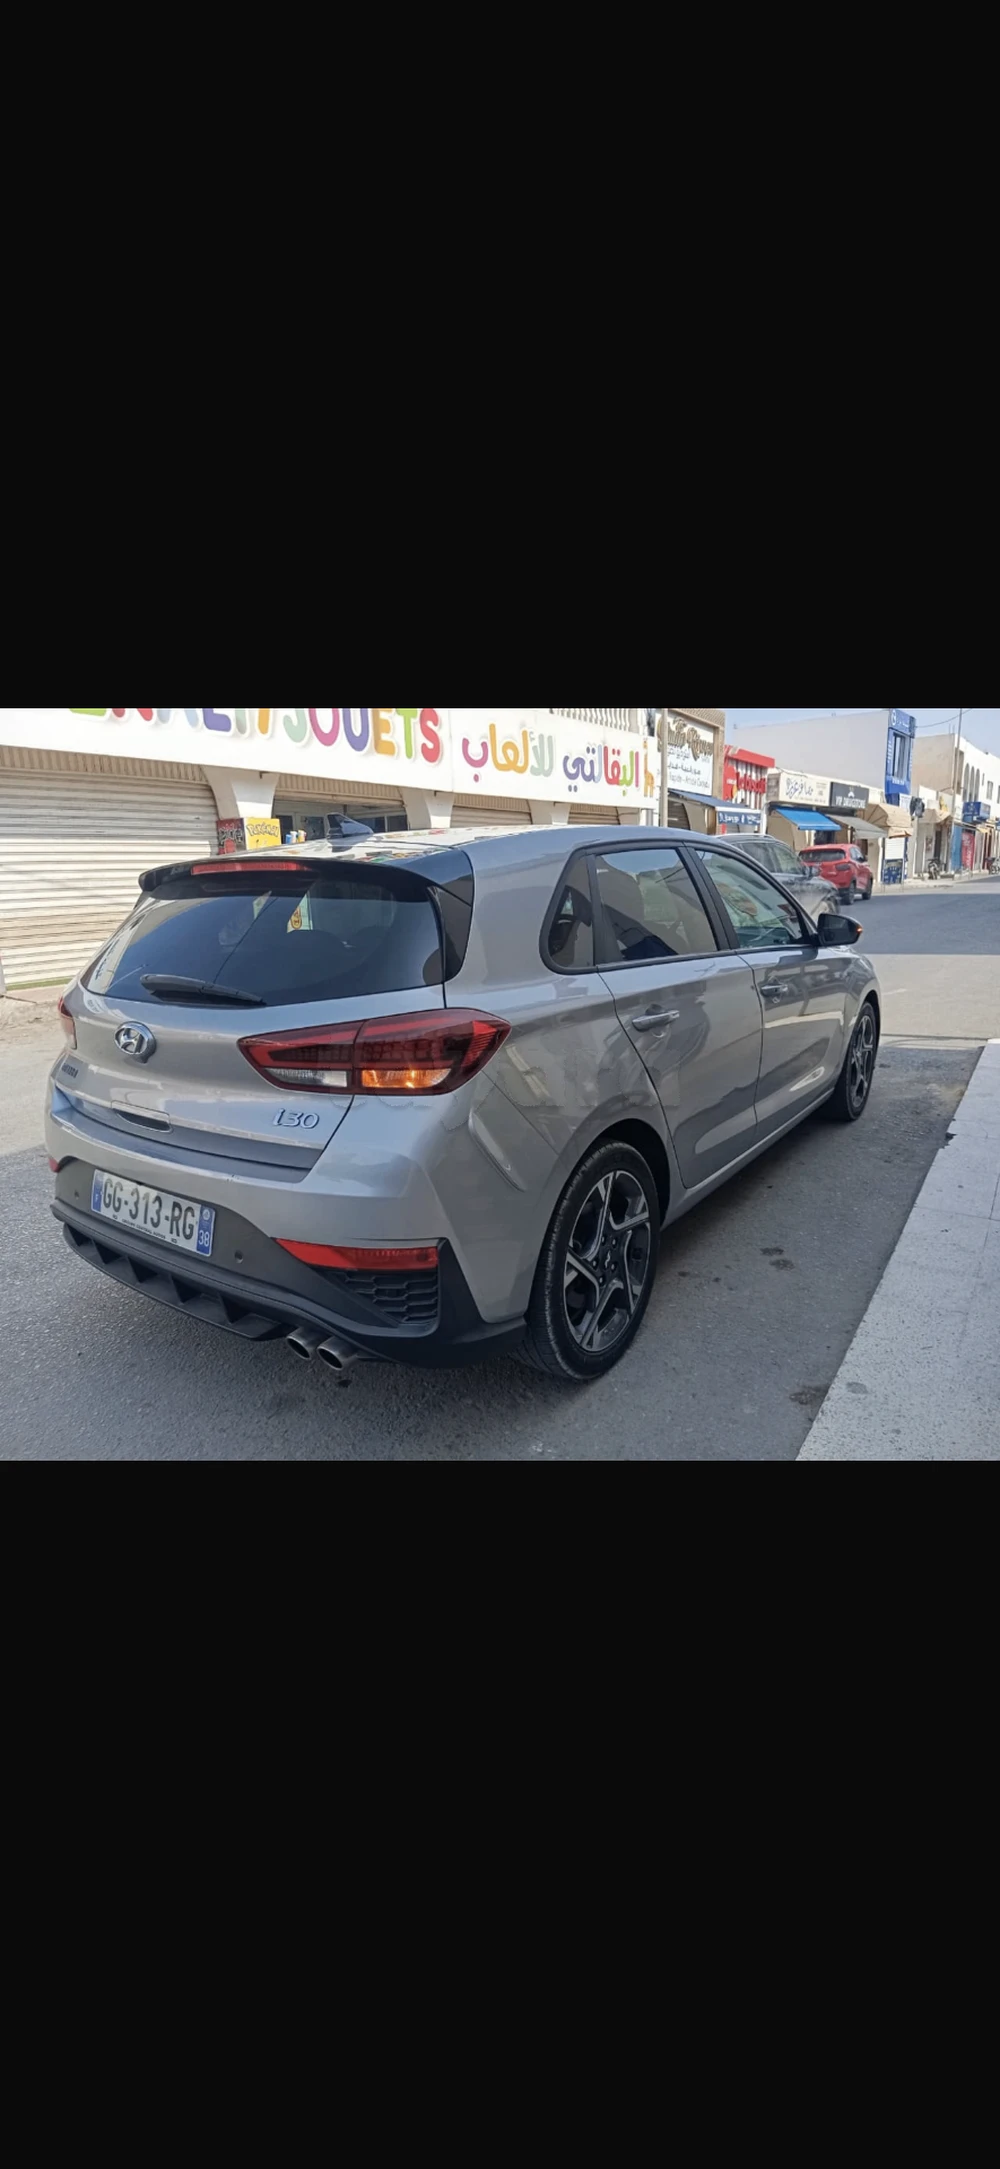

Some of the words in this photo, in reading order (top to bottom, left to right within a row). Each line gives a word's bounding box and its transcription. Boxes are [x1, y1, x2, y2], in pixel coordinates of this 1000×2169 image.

[283, 708, 440, 763] JOUETS
[462, 723, 554, 783] للألعاب
[103, 1178, 195, 1240] GG-313-RG
[198, 1229, 210, 1248] 38
